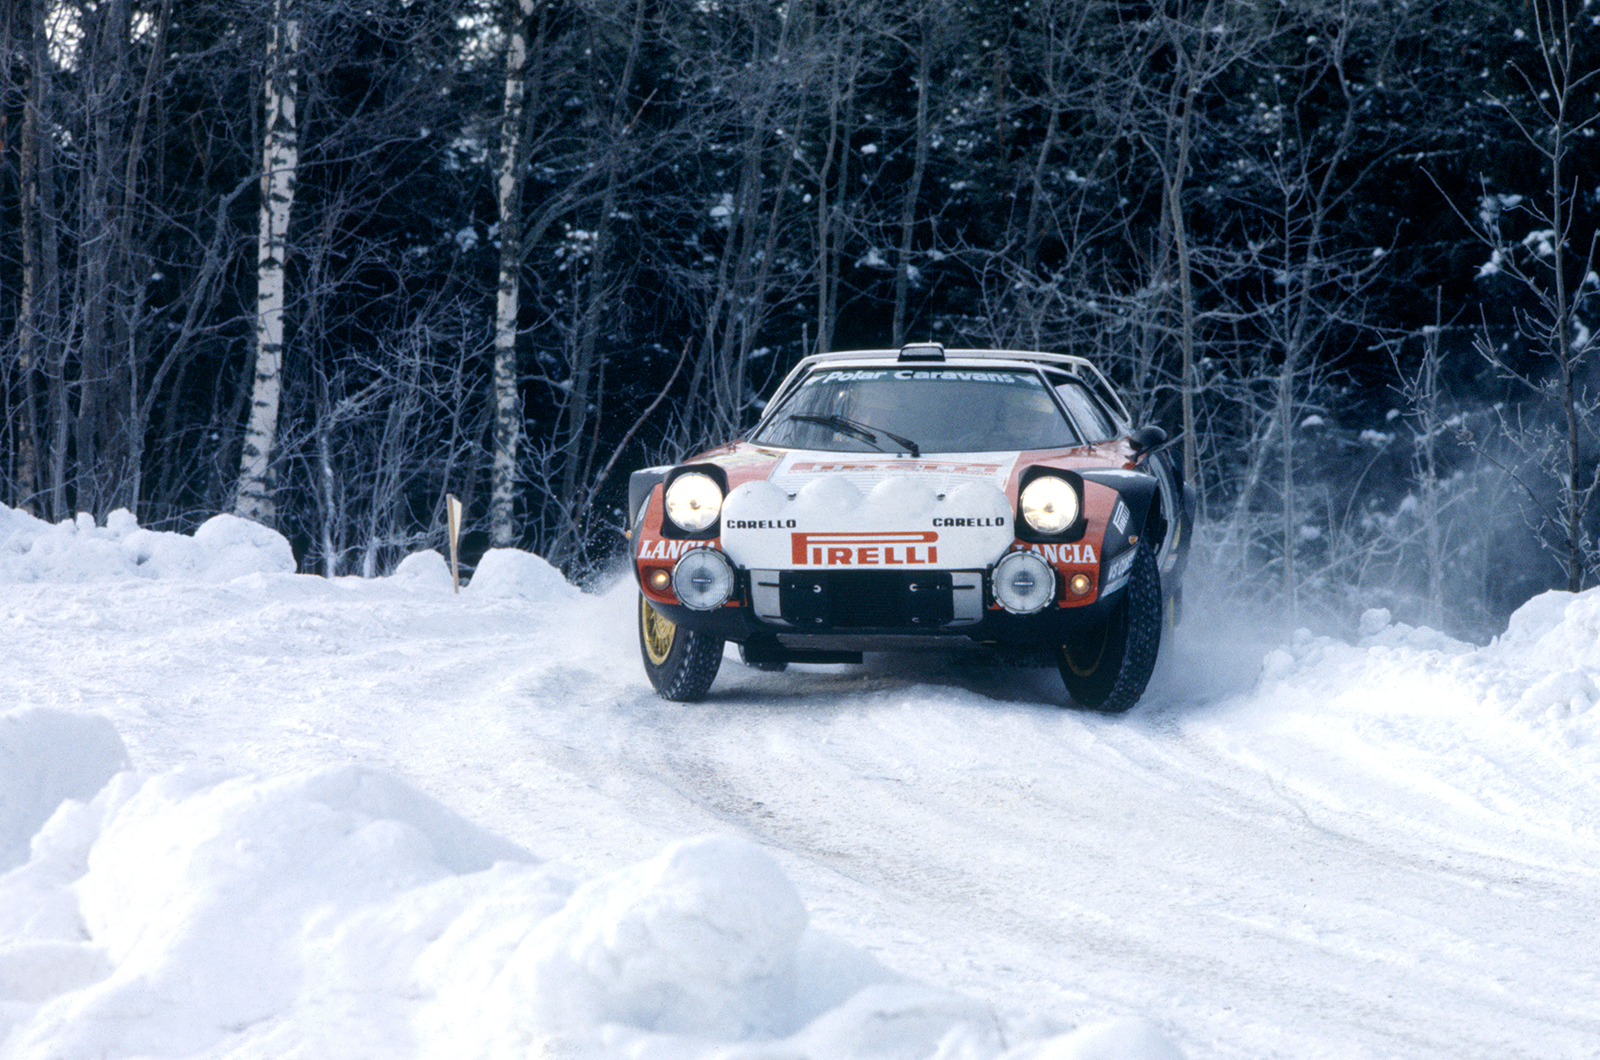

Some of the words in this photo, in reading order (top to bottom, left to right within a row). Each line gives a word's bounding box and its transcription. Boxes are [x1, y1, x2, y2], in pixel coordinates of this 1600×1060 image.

[822, 370, 888, 384] Polar
[893, 370, 1016, 384] Caravans
[726, 519, 797, 529] CARELLO
[932, 516, 1005, 527] CARELLO
[638, 540, 715, 559] LANC
[791, 531, 939, 565] PIRELLI
